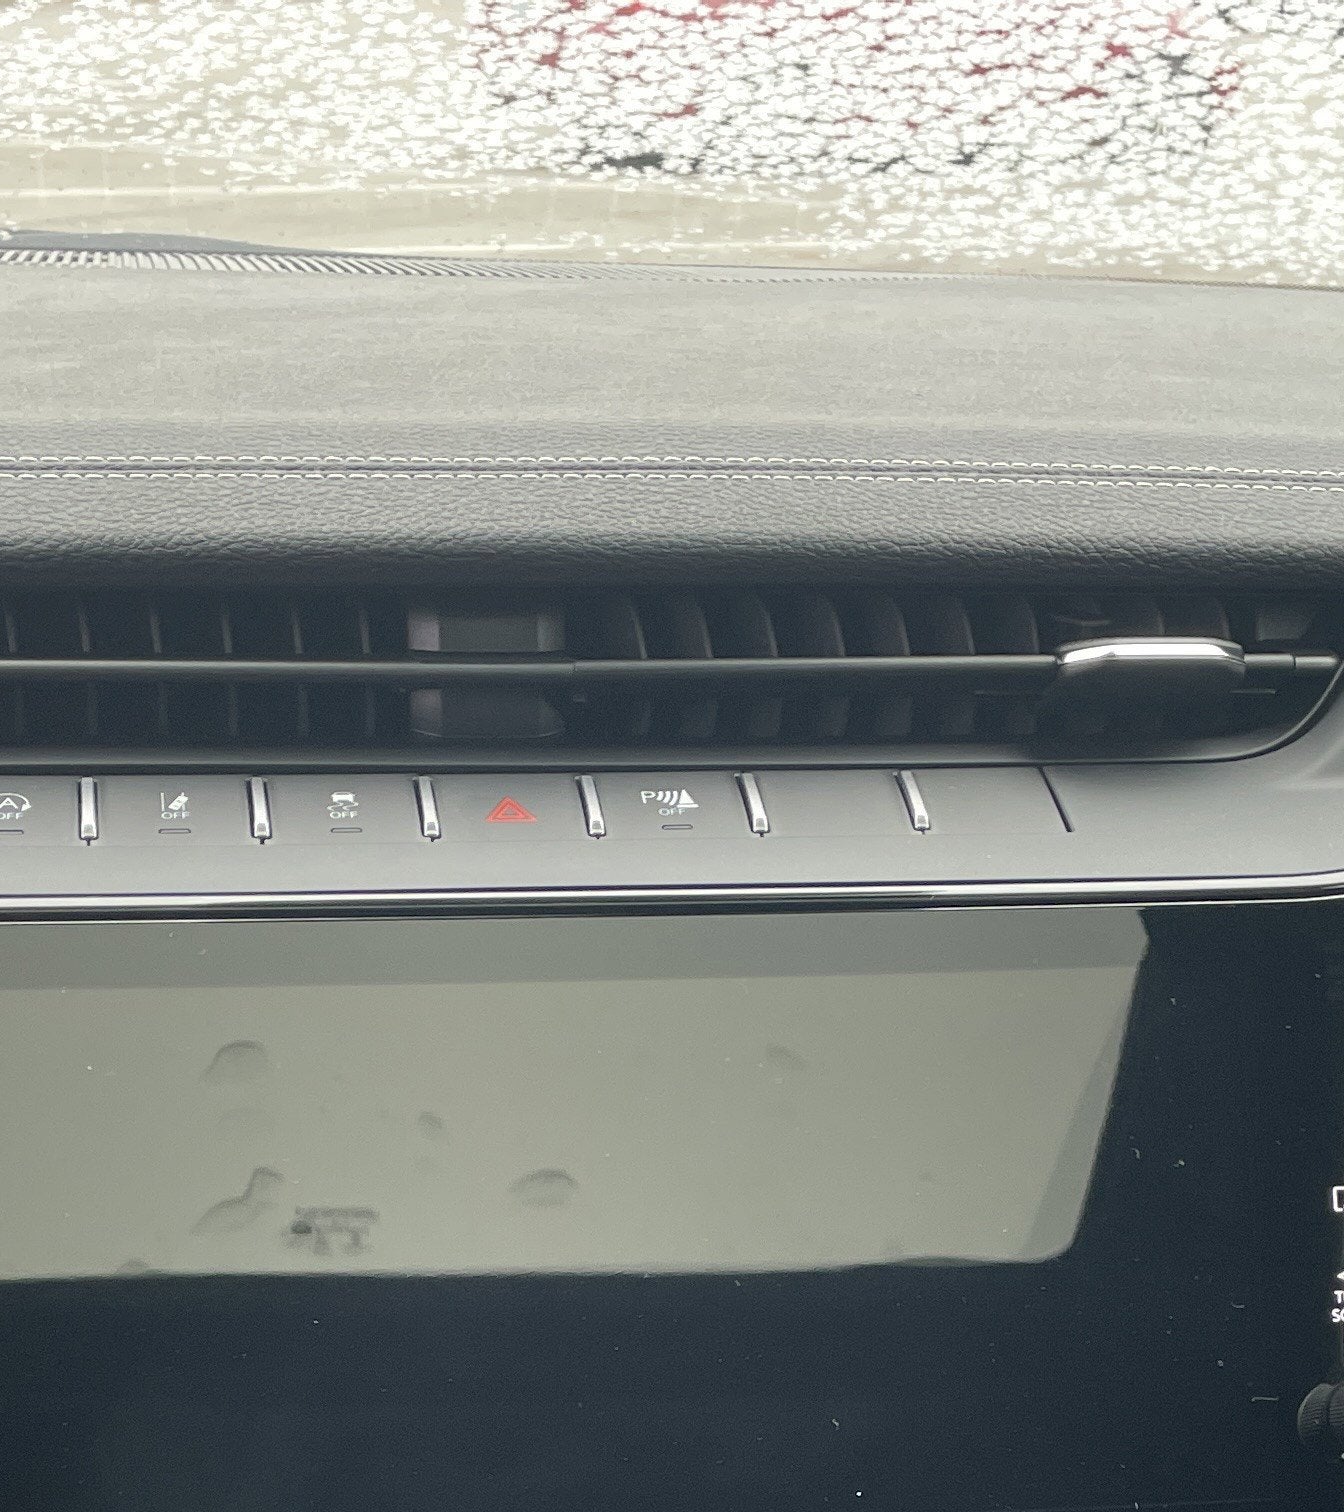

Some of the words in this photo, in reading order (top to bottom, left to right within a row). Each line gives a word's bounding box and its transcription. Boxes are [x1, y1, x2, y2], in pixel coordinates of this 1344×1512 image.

[161, 811, 190, 820] OFF
[329, 811, 359, 820] OFF
[658, 807, 687, 816] OFF
